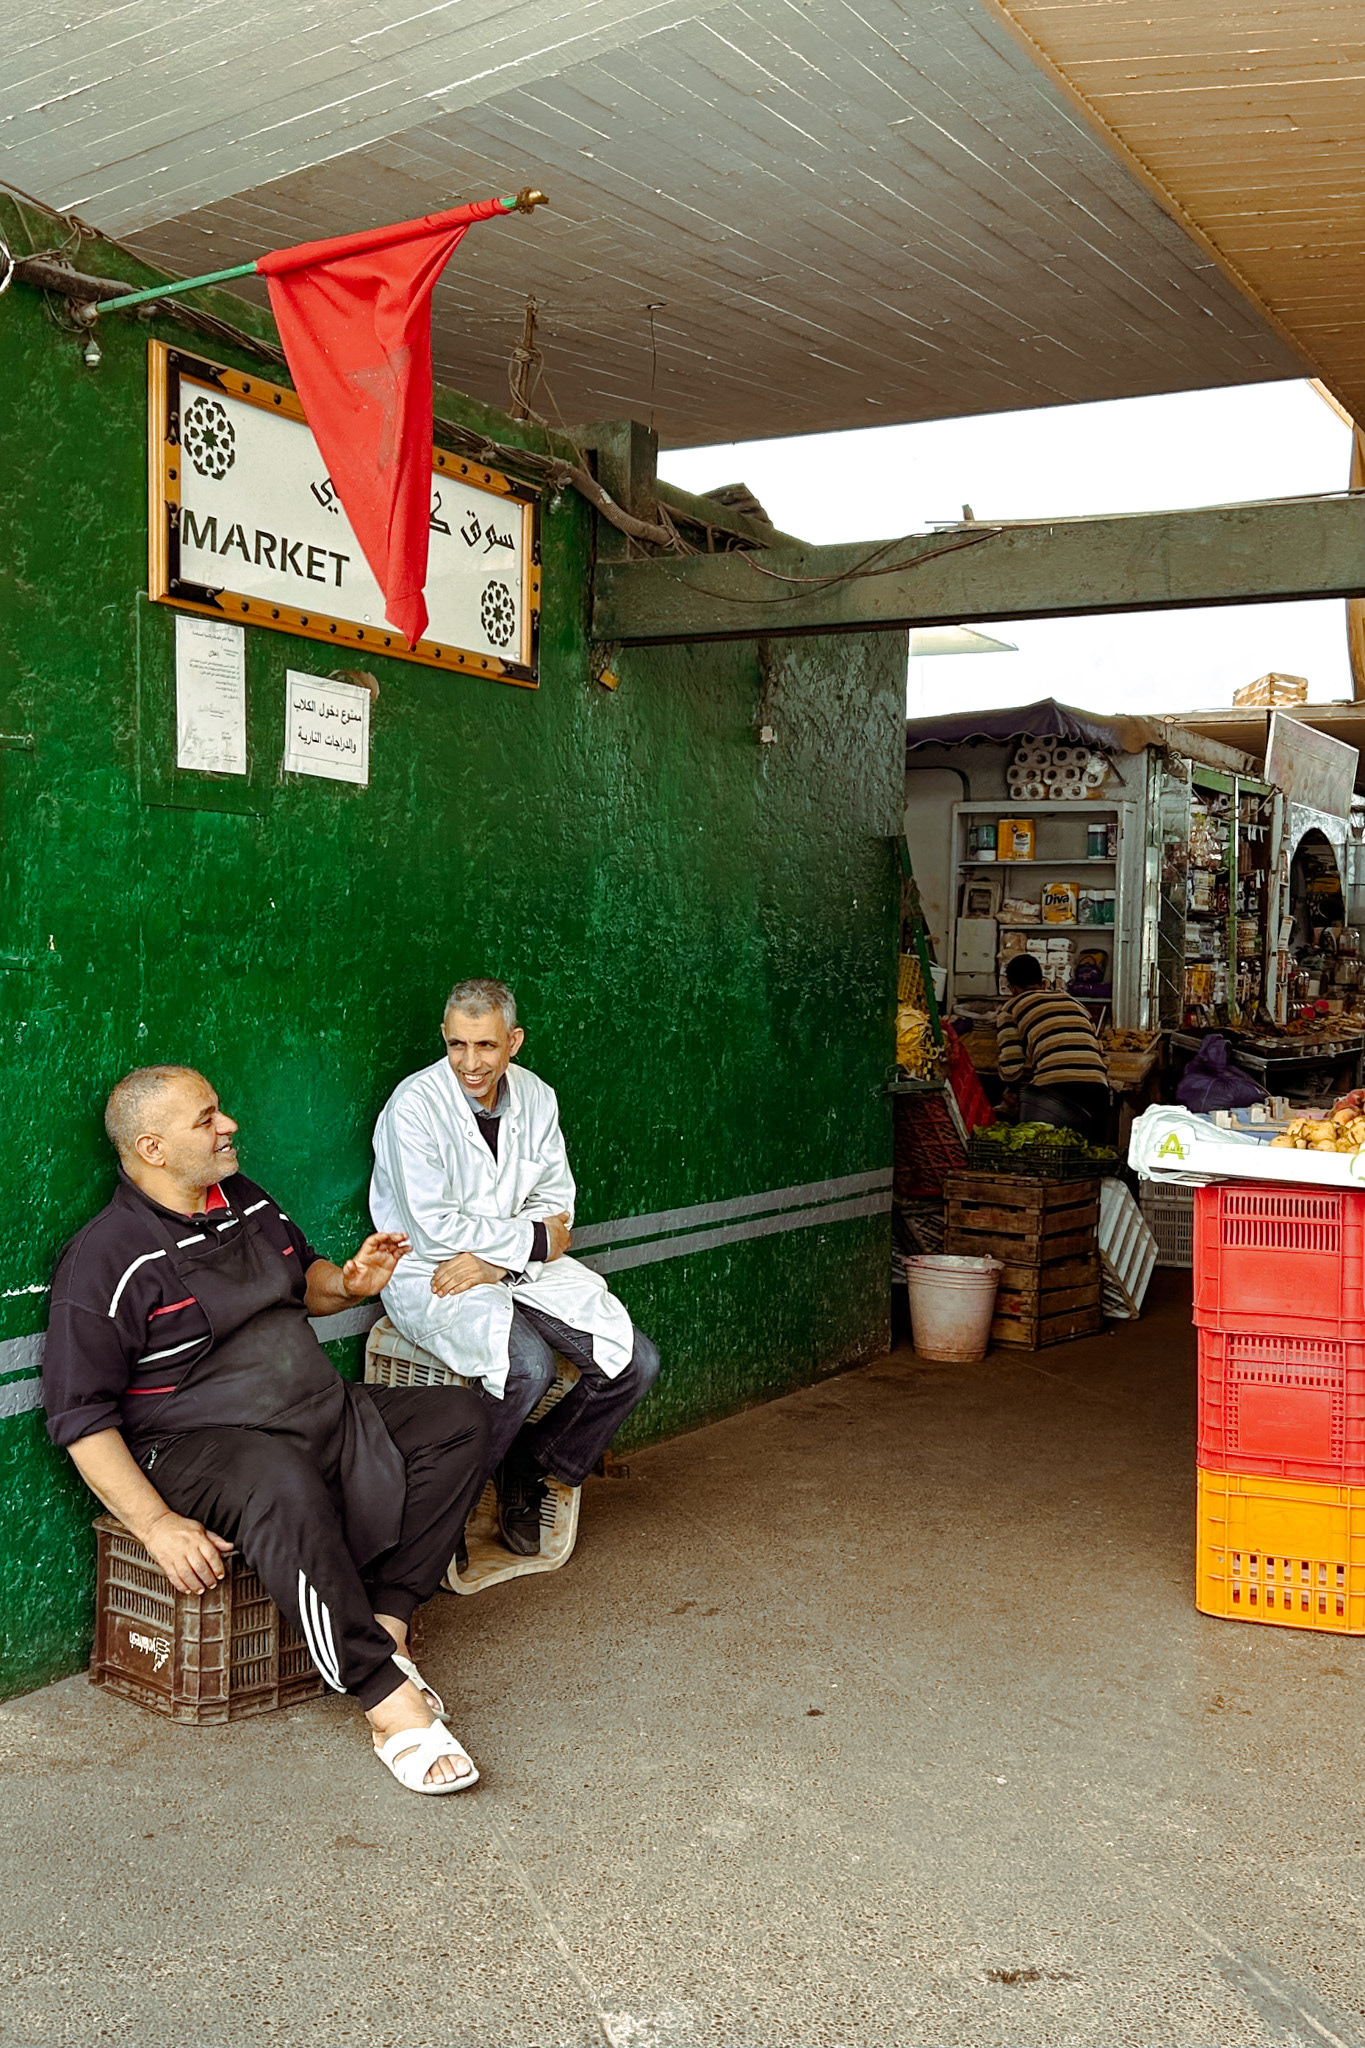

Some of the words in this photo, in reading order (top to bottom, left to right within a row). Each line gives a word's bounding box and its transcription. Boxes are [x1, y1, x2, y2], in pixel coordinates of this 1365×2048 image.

[460, 510, 515, 554] سوق
[181, 509, 350, 588] MARKET
[293, 698, 316, 712] الكلاب
[319, 702, 339, 718] دخول
[341, 709, 362, 725] ممنوع
[297, 725, 321, 745] النارية
[325, 735, 357, 754] والدراجات
[1045, 893, 1070, 905] Diva
